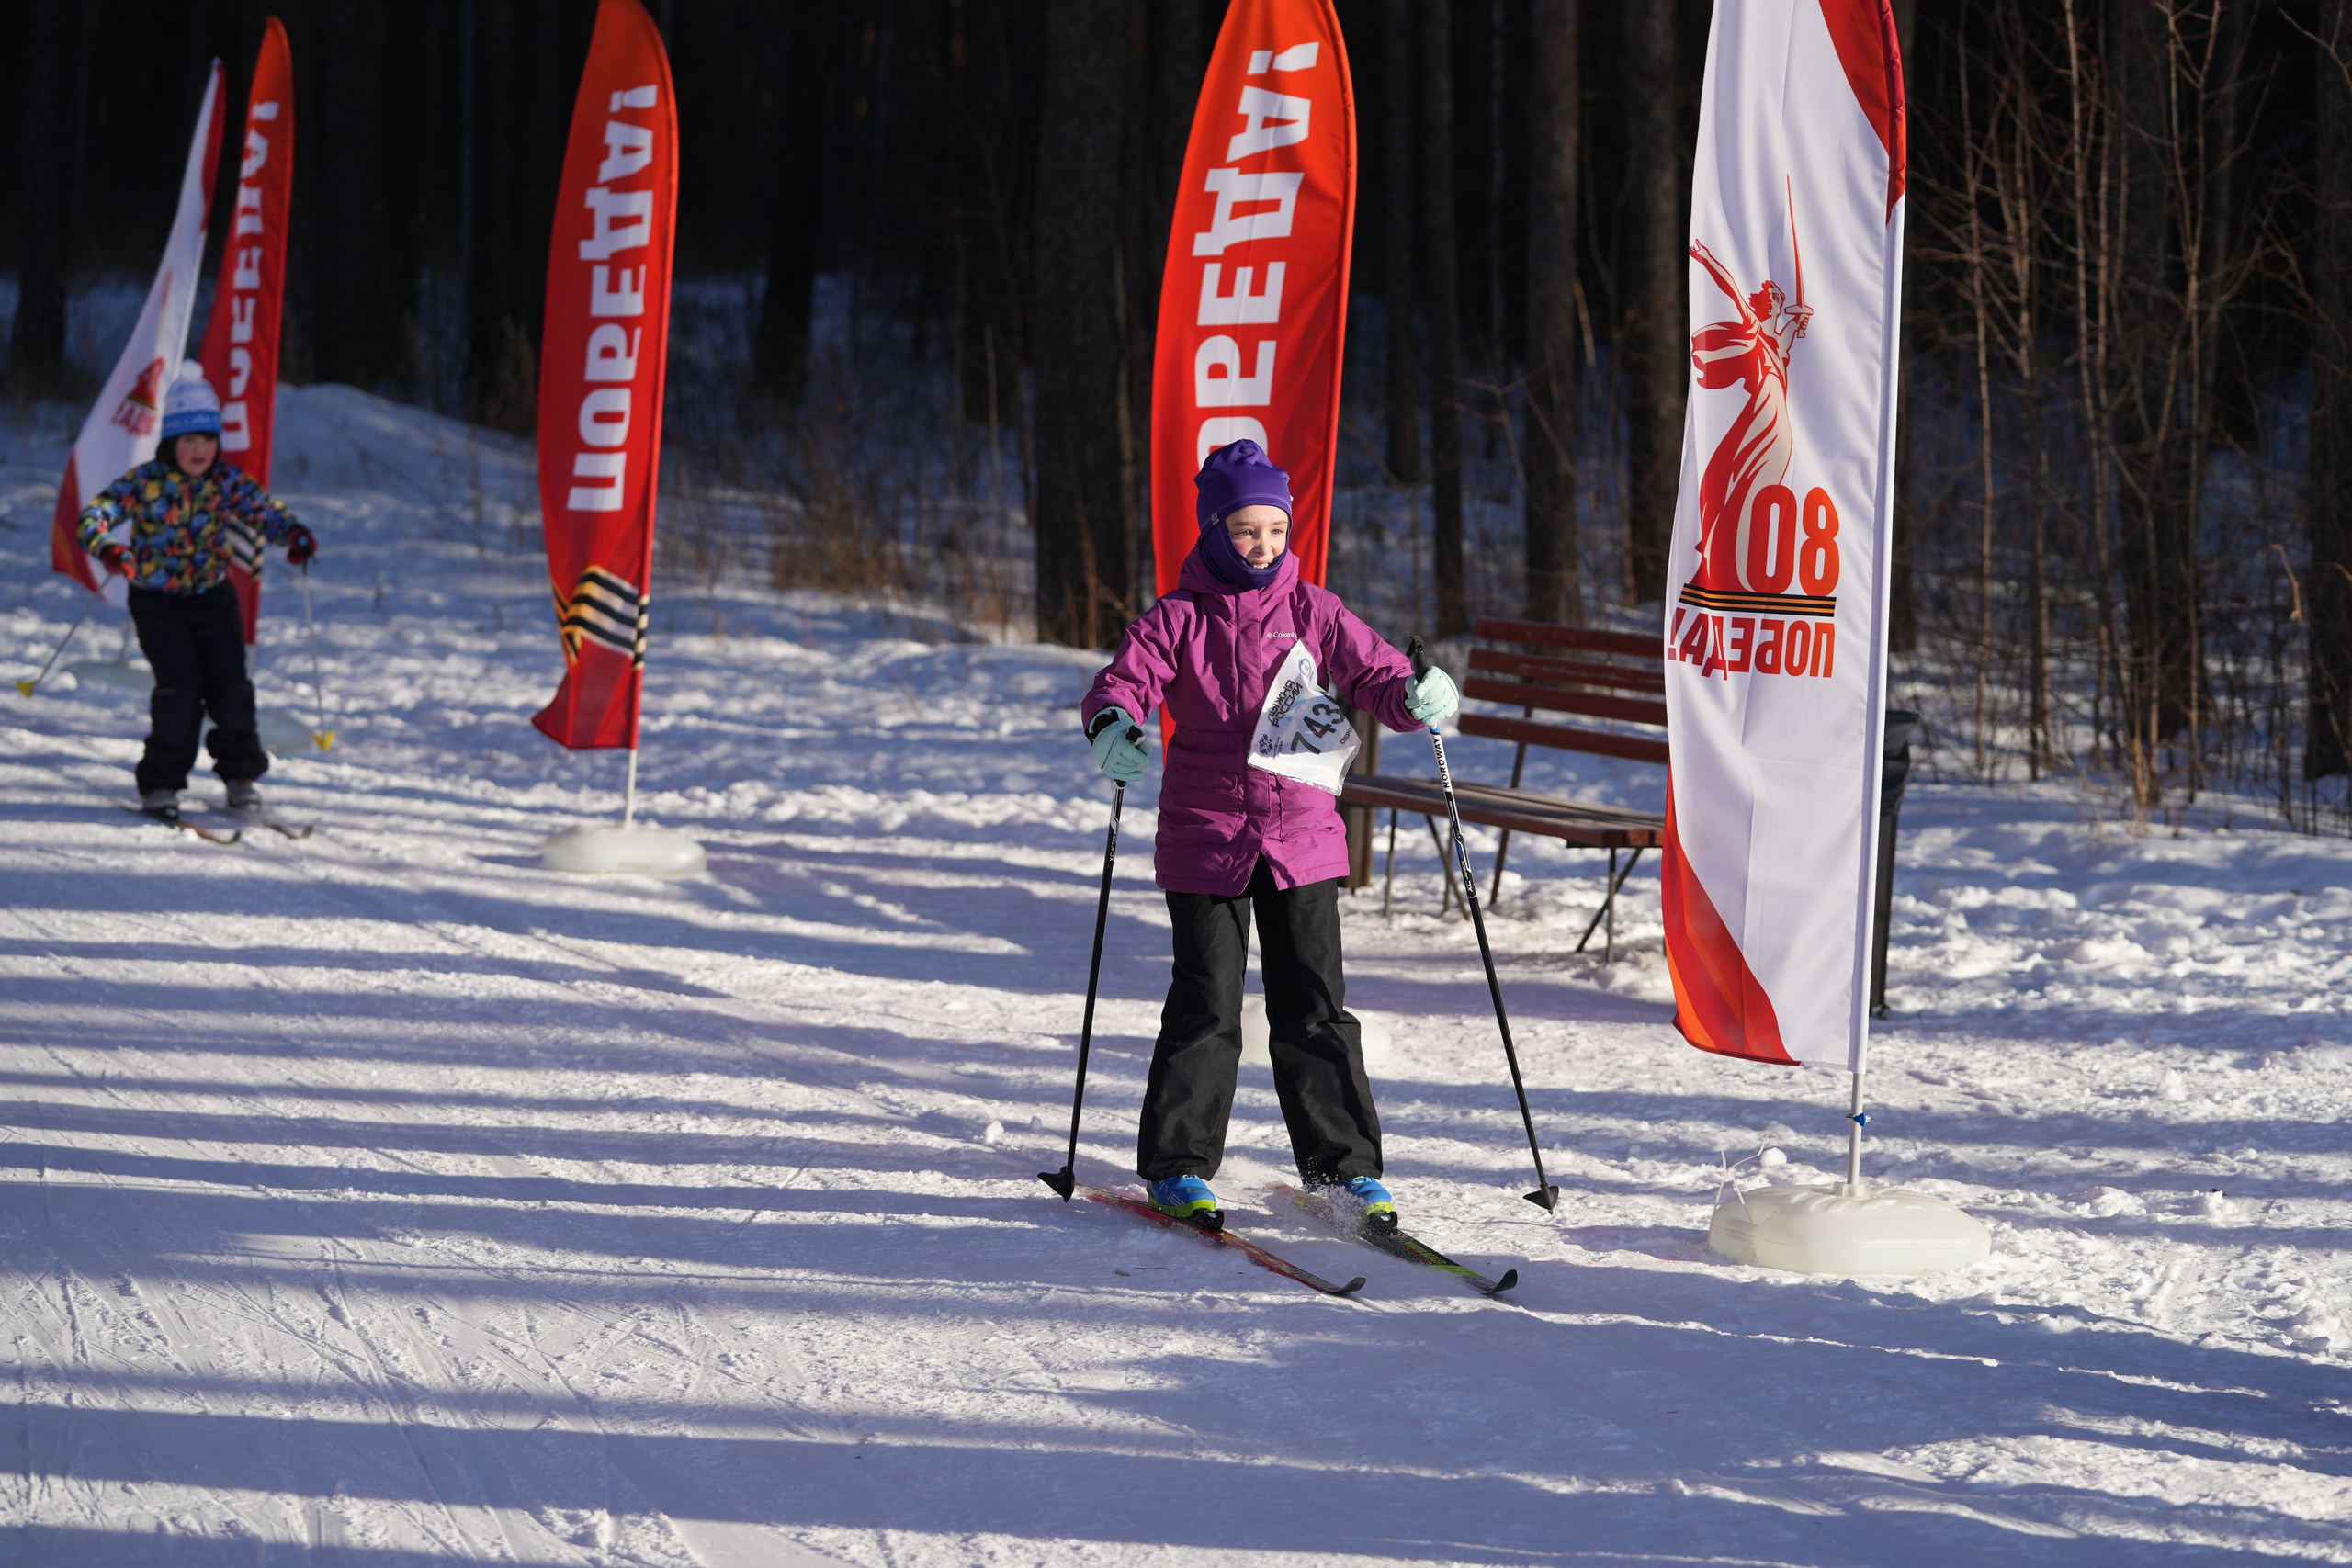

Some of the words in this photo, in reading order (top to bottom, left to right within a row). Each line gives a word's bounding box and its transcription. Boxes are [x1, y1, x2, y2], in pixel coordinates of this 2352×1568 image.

[1268, 679, 1295, 723] ЛЫЖНЯ
[1272, 682, 1303, 728] РОССИИ
[1433, 739, 1450, 788] NORDWAY
